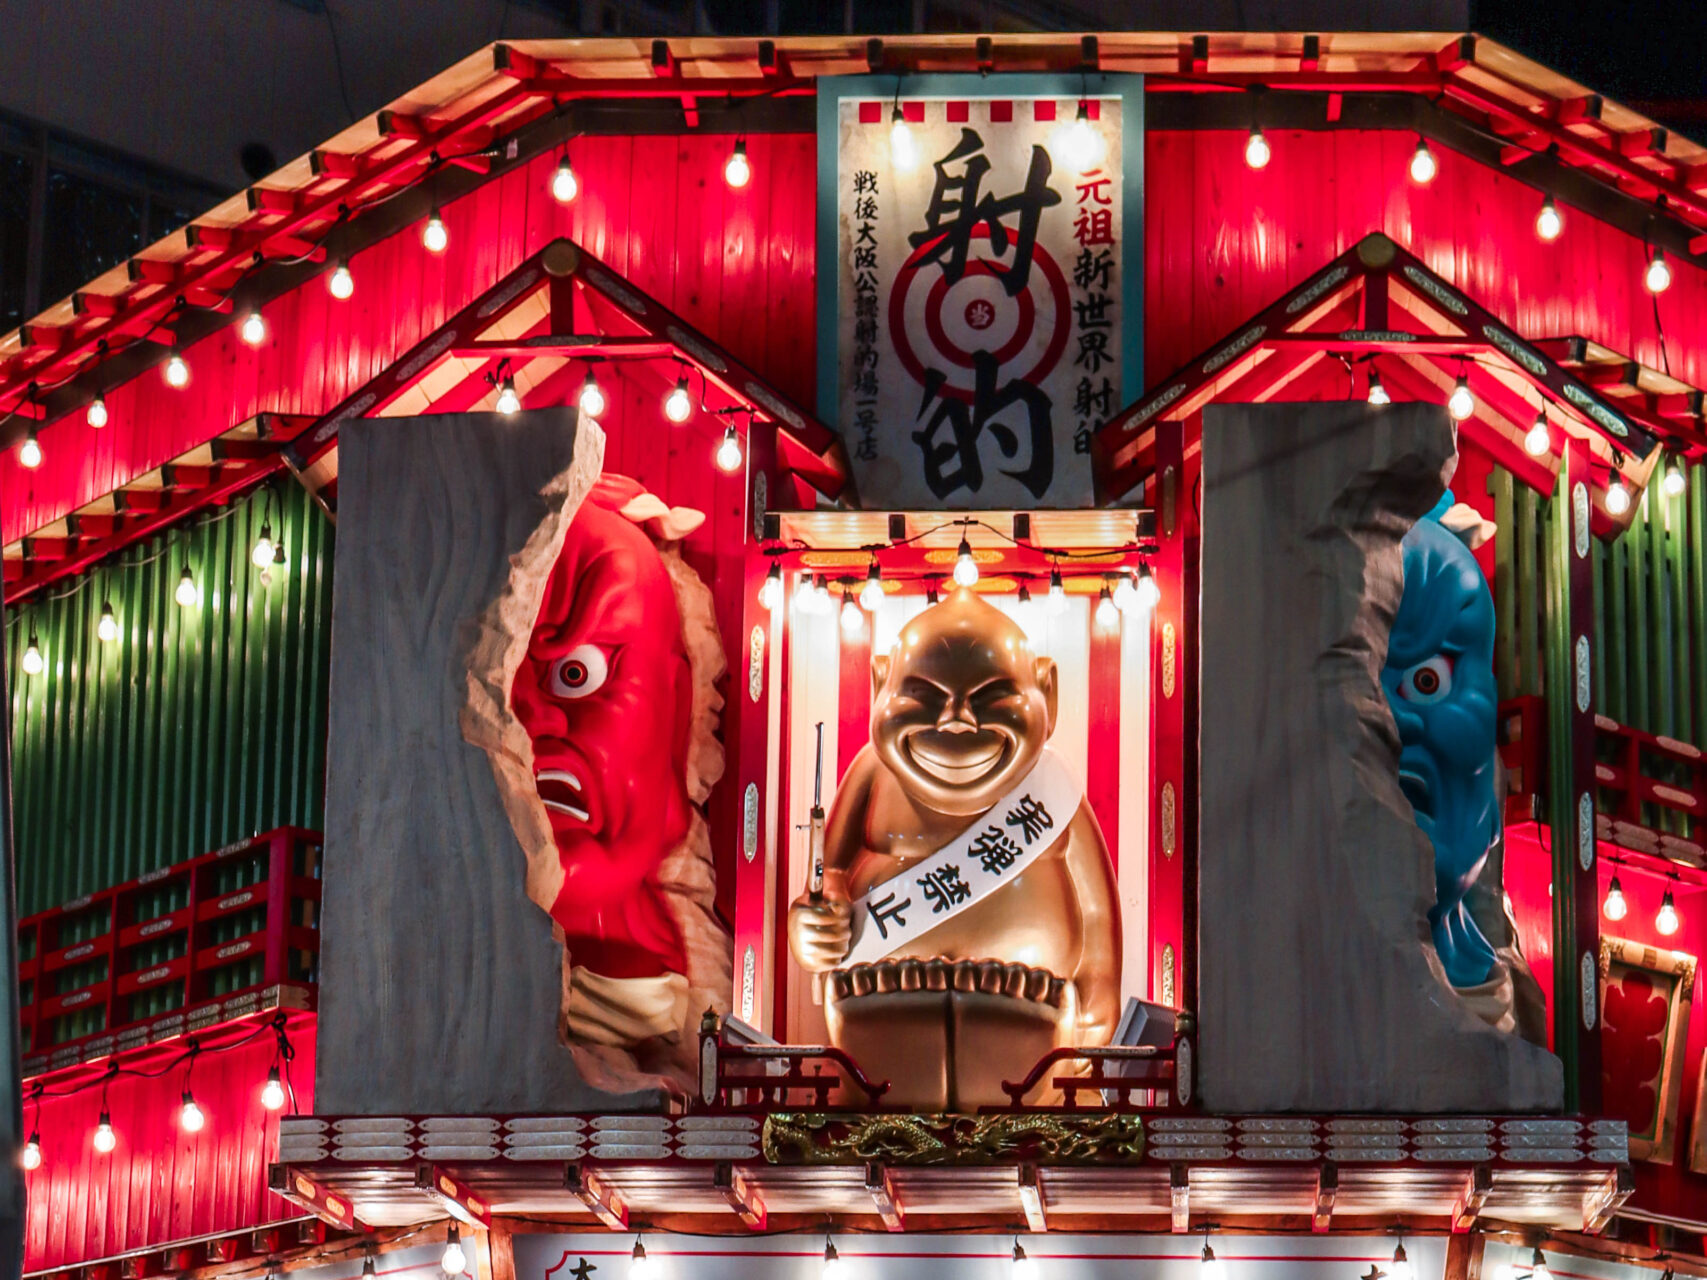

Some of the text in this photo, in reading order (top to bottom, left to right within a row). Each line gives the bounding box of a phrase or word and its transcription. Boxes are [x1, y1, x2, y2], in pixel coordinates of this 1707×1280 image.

[853, 170, 879, 461] 戦後大阪公認射的場一号店
[907, 126, 1062, 500] 射的
[866, 793, 1054, 940] 実弾禁止
